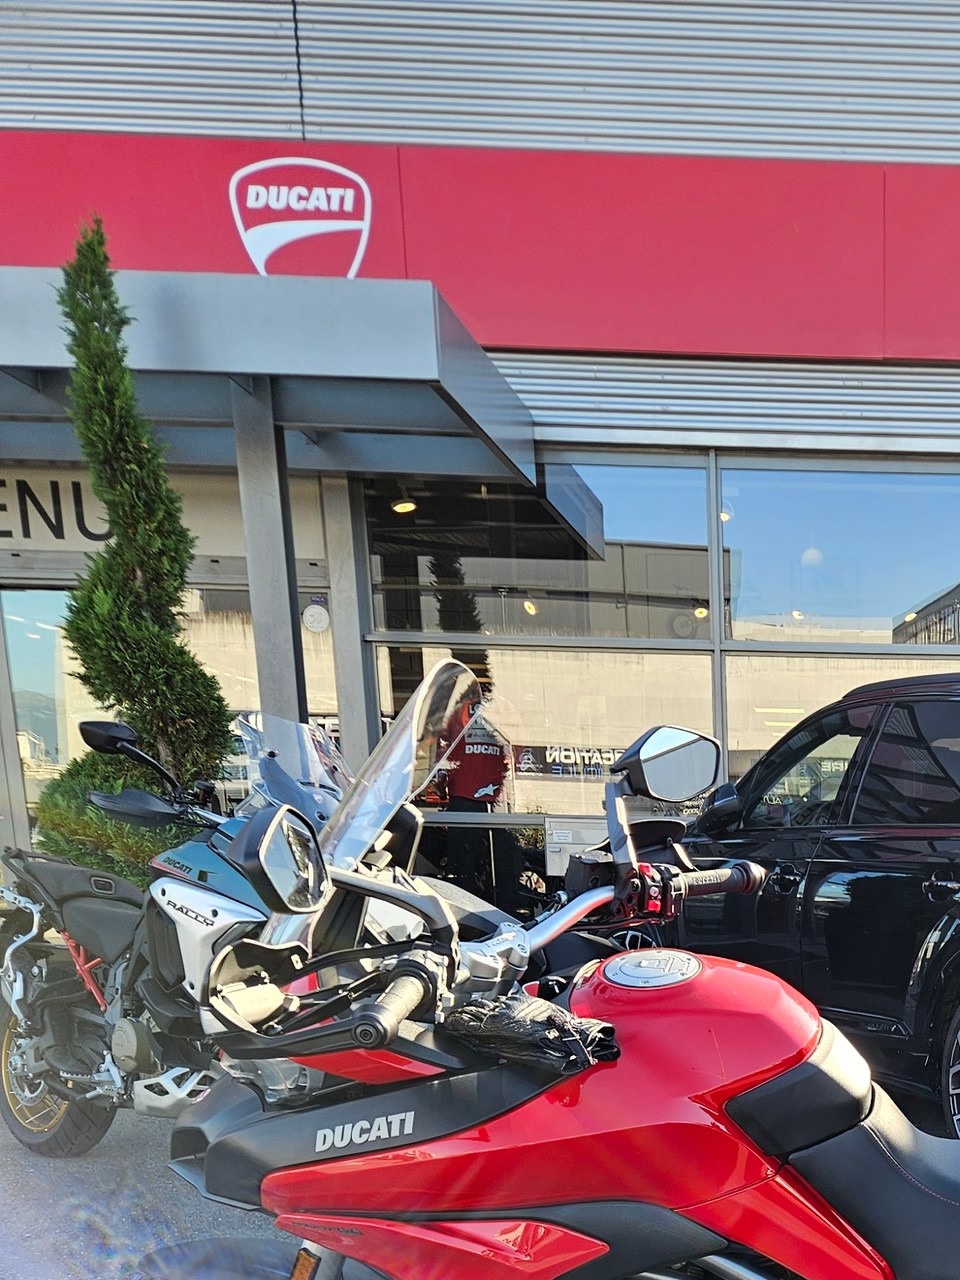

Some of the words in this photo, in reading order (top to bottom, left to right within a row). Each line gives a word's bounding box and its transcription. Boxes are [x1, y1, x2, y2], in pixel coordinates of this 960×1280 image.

[246, 184, 355, 213] DUCATI
[465, 744, 500, 756] DUCATI
[162, 856, 193, 875] DUCATI
[166, 899, 216, 927] RALLY
[315, 1111, 415, 1153] DUCATI
